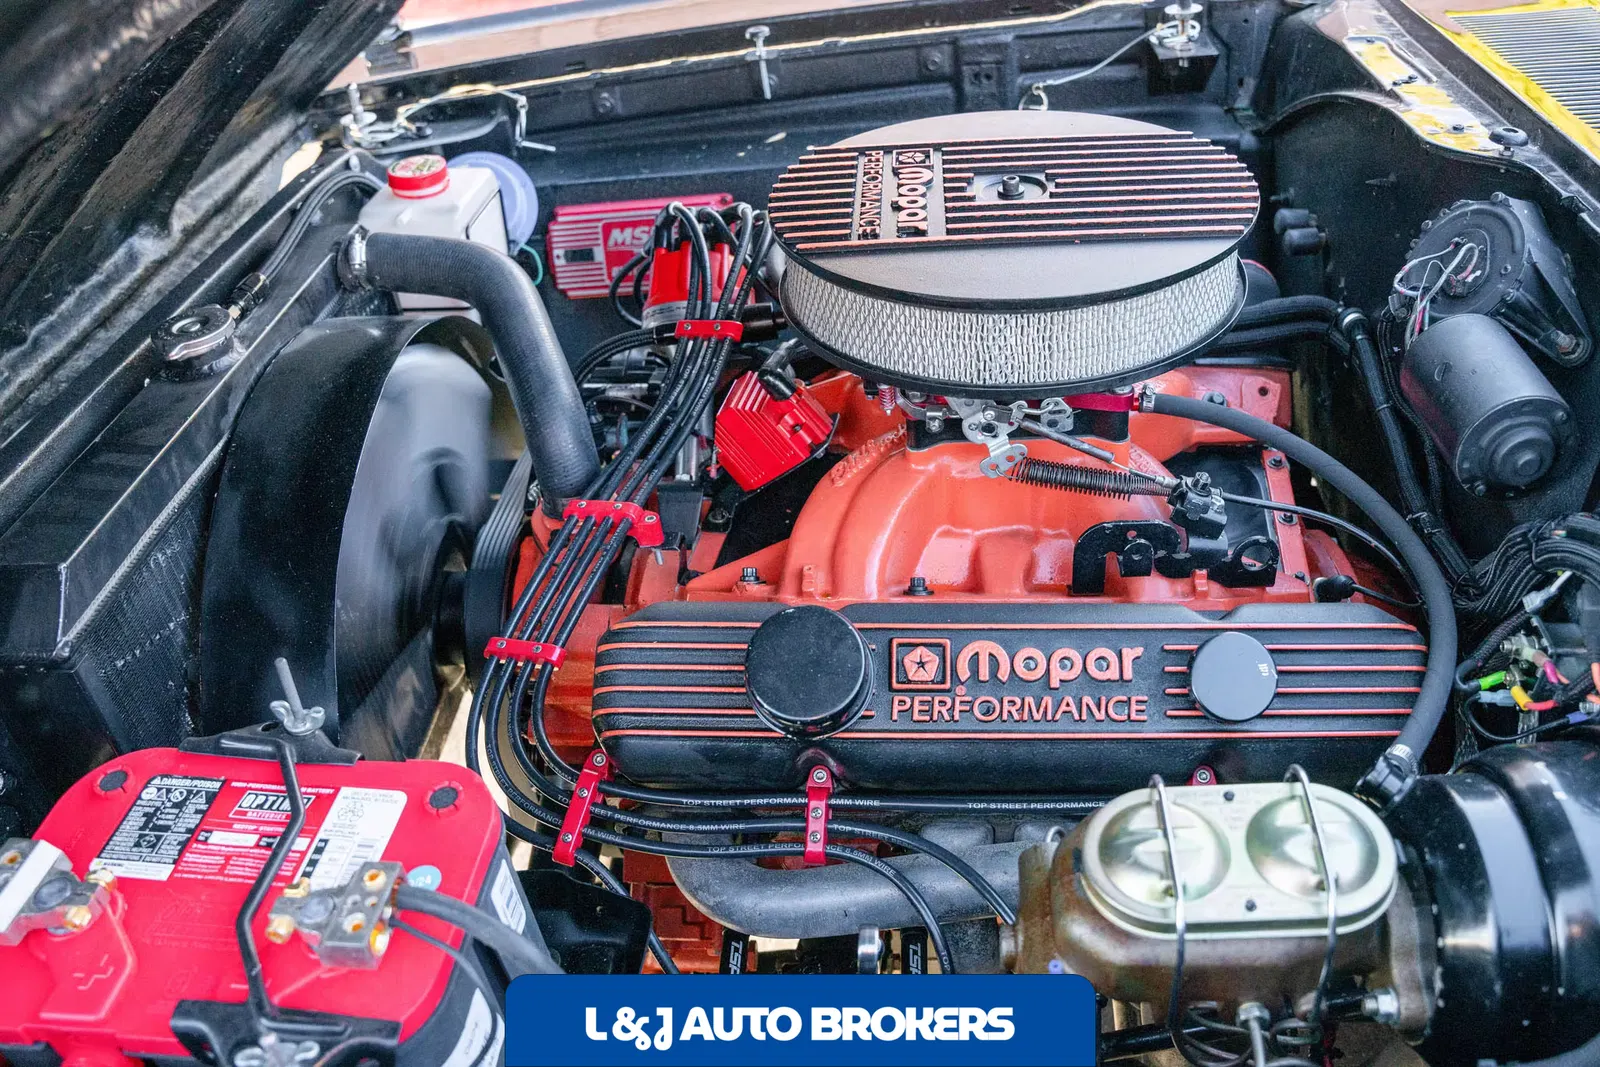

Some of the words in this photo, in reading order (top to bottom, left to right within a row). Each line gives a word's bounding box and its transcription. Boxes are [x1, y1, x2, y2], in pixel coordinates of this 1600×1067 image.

[858, 150, 883, 237] PERFORMANCE
[890, 167, 933, 231] Mopar
[608, 226, 655, 247] MS
[956, 640, 1144, 689] Mopar
[891, 696, 1148, 722] PERFORMANCE
[240, 793, 308, 811] OPTIM
[682, 799, 701, 807] TOP
[703, 799, 741, 807] STREET
[743, 797, 809, 806] PERFORMANC
[828, 798, 853, 806] .5MM
[855, 799, 881, 807] WIRE
[1030, 801, 1106, 809] PERFORMANCE
[614, 813, 687, 831] PERFORMANCE
[689, 823, 719, 832] 8.5MM
[721, 823, 746, 831] WIRE
[833, 823, 853, 833] TOP
[728, 844, 765, 853] STREET
[874, 860, 897, 877] WIRE
